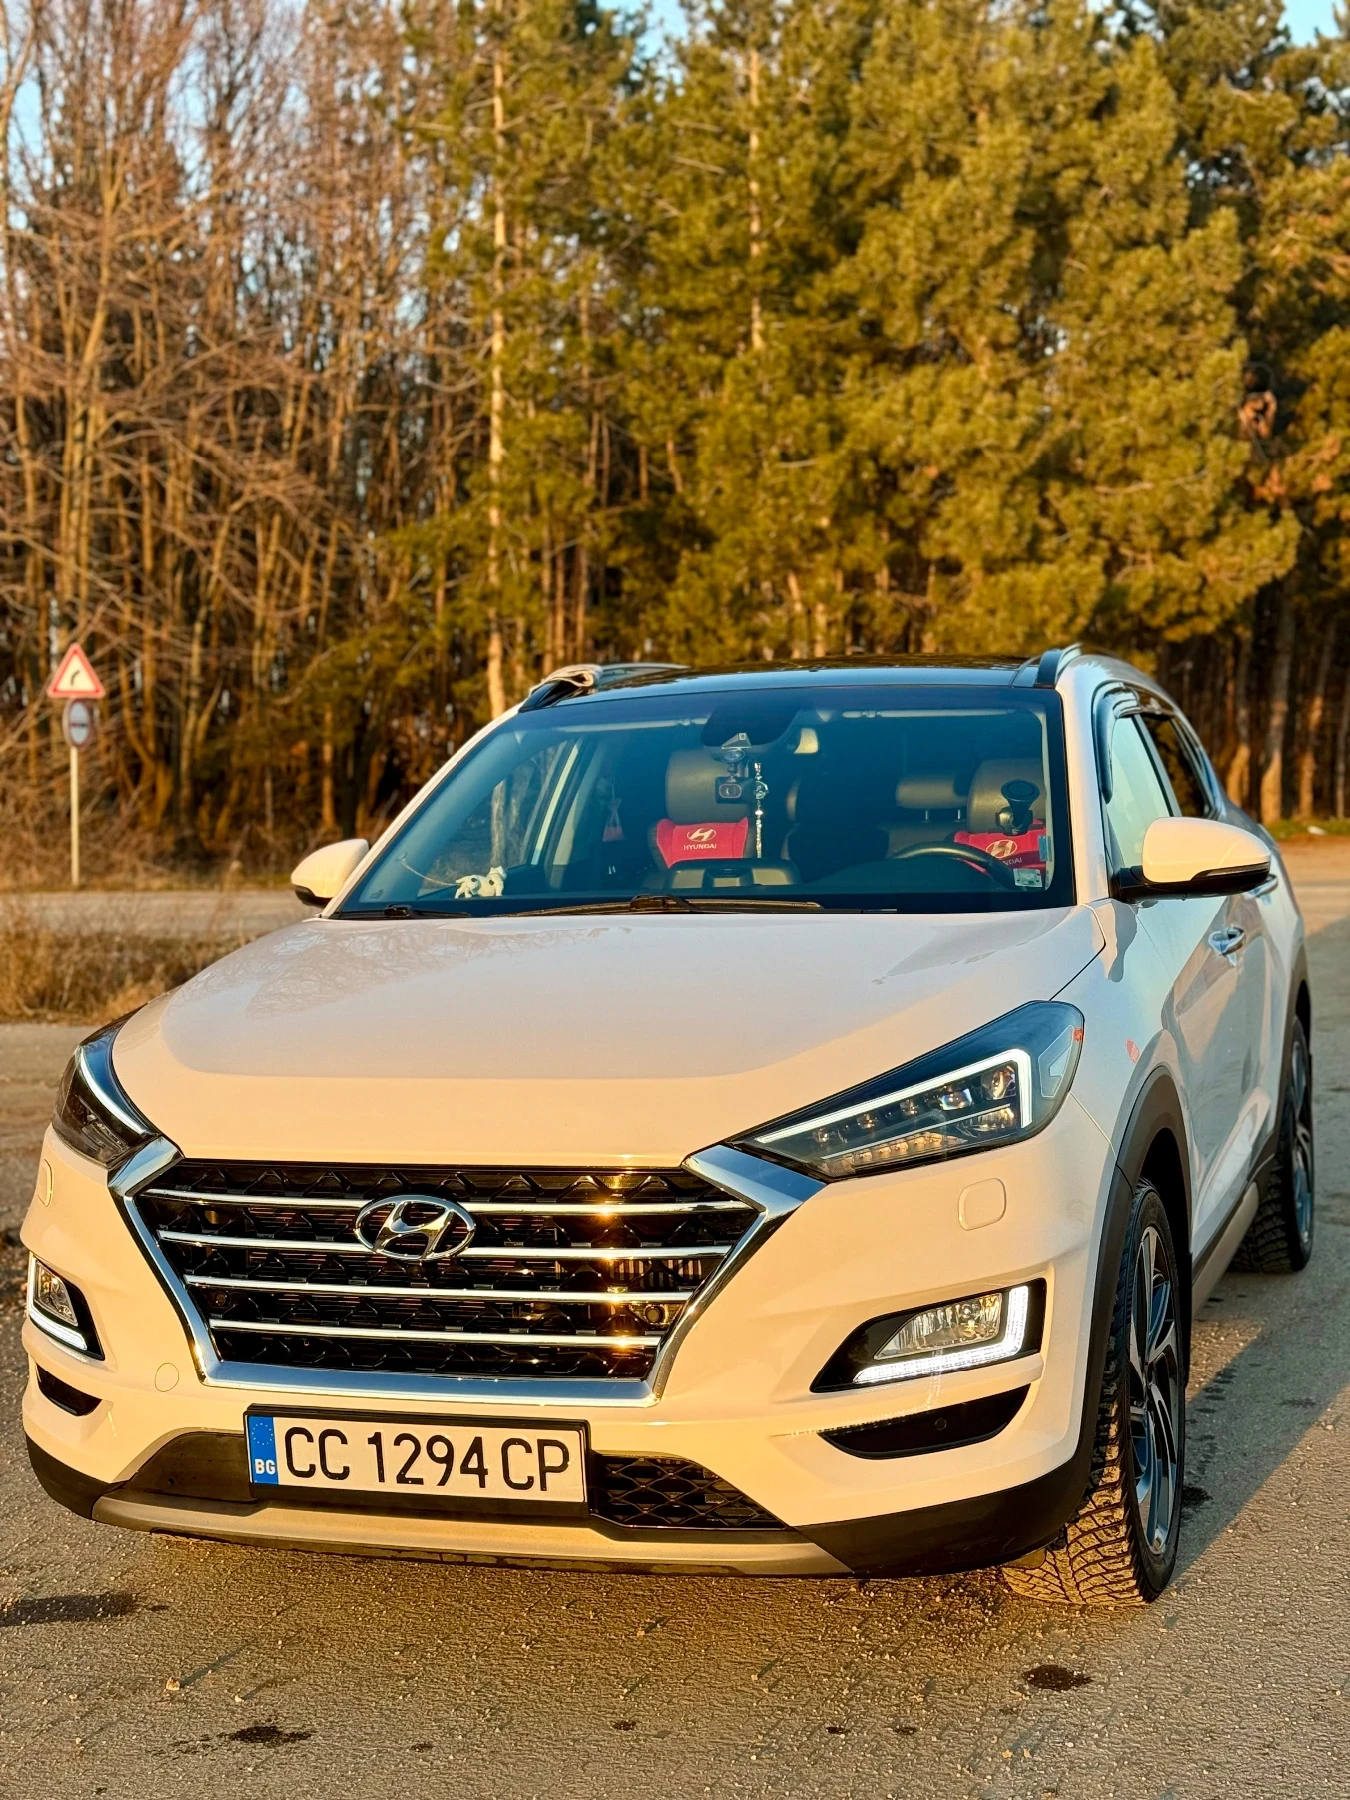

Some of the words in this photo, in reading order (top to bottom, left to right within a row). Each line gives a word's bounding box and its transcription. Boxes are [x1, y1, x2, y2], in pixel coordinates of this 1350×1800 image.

[683, 843, 717, 851] HYUNDAI
[1002, 857, 1023, 866] NDAI
[284, 1426, 350, 1481] CC
[367, 1431, 489, 1489] 1294
[500, 1437, 570, 1492] CP
[254, 1458, 276, 1475] BG
